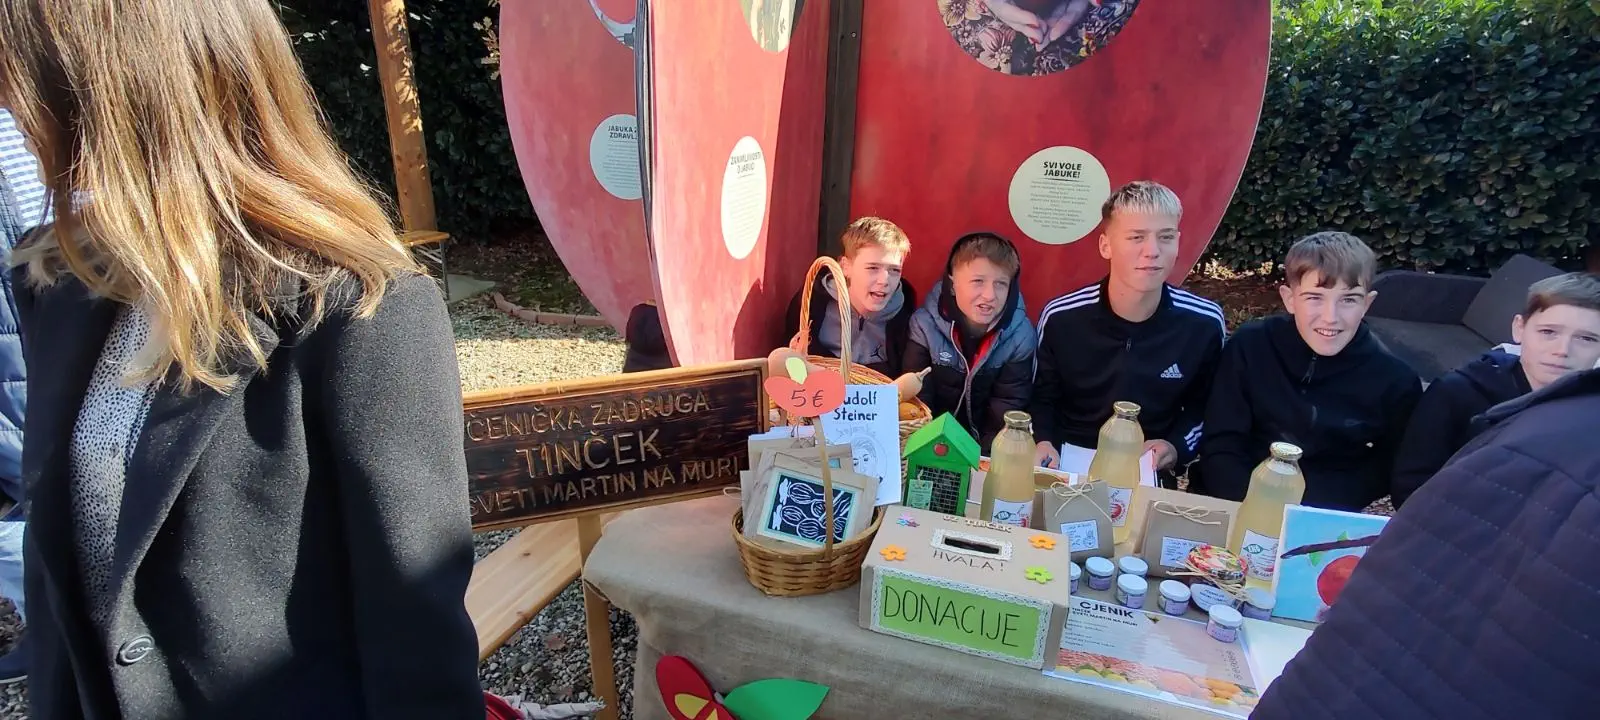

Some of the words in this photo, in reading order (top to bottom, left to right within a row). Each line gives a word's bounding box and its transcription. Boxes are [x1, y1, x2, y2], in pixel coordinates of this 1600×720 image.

[609, 131, 637, 140] ZDRAVL
[1043, 161, 1058, 169] SVI
[1059, 162, 1082, 171] VOLE
[1044, 169, 1081, 179] JABUKE!
[791, 389, 807, 407] 5
[843, 391, 878, 406] udolf
[591, 391, 710, 427] ZADRUGA
[833, 408, 878, 421] Steiner
[516, 428, 662, 479] TINČEK
[543, 471, 636, 505] MARTIN
[644, 466, 676, 490] NA
[682, 456, 738, 485] MURI
[883, 586, 1021, 648] DONACIJE
[1080, 601, 1134, 619] CJENIK
